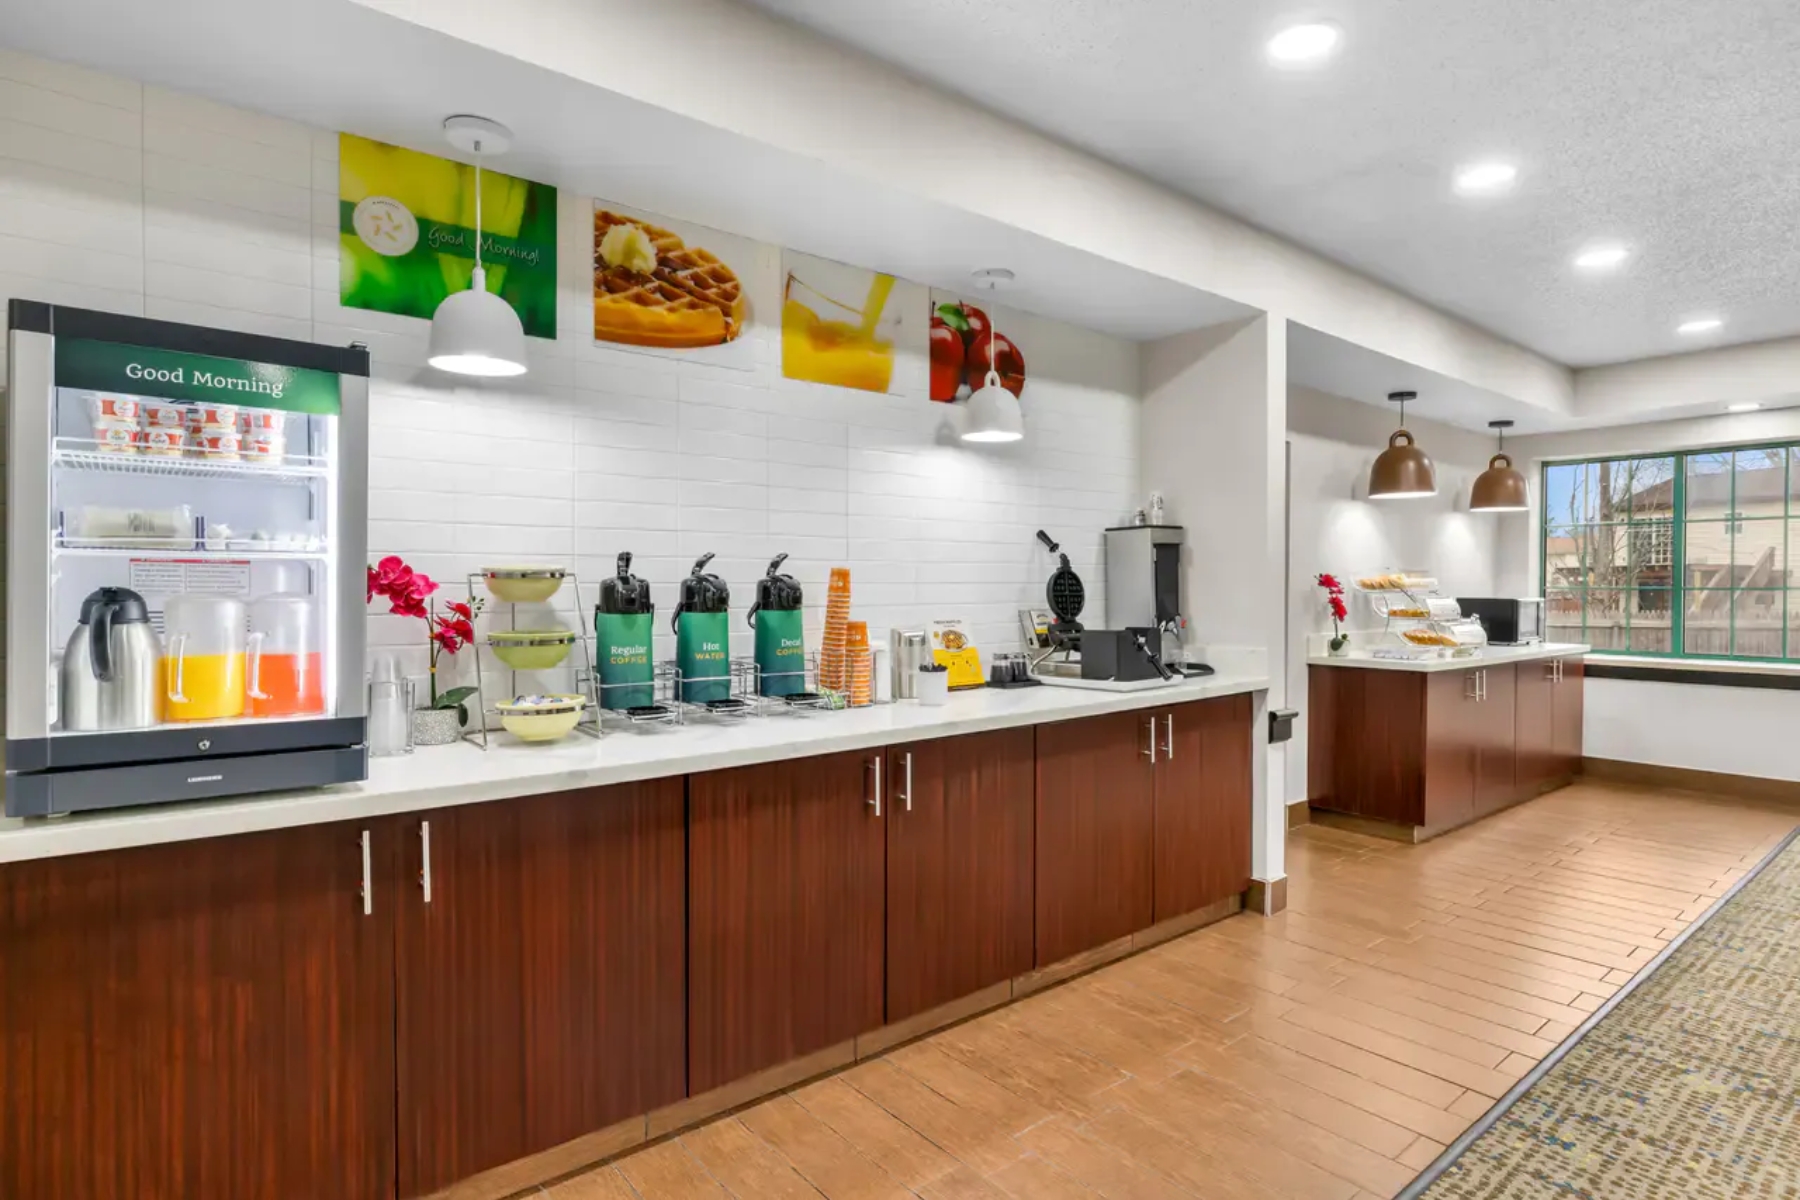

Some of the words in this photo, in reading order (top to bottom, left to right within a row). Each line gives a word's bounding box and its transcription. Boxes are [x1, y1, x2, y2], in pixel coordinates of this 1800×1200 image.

[428, 225, 464, 248] Good
[469, 236, 540, 267] Morning!
[126, 363, 184, 384] Good
[192, 370, 283, 399] Morning
[611, 645, 648, 657] Regular
[702, 641, 720, 651] Hot
[610, 656, 648, 665] COFFEE
[695, 651, 725, 660] WATER
